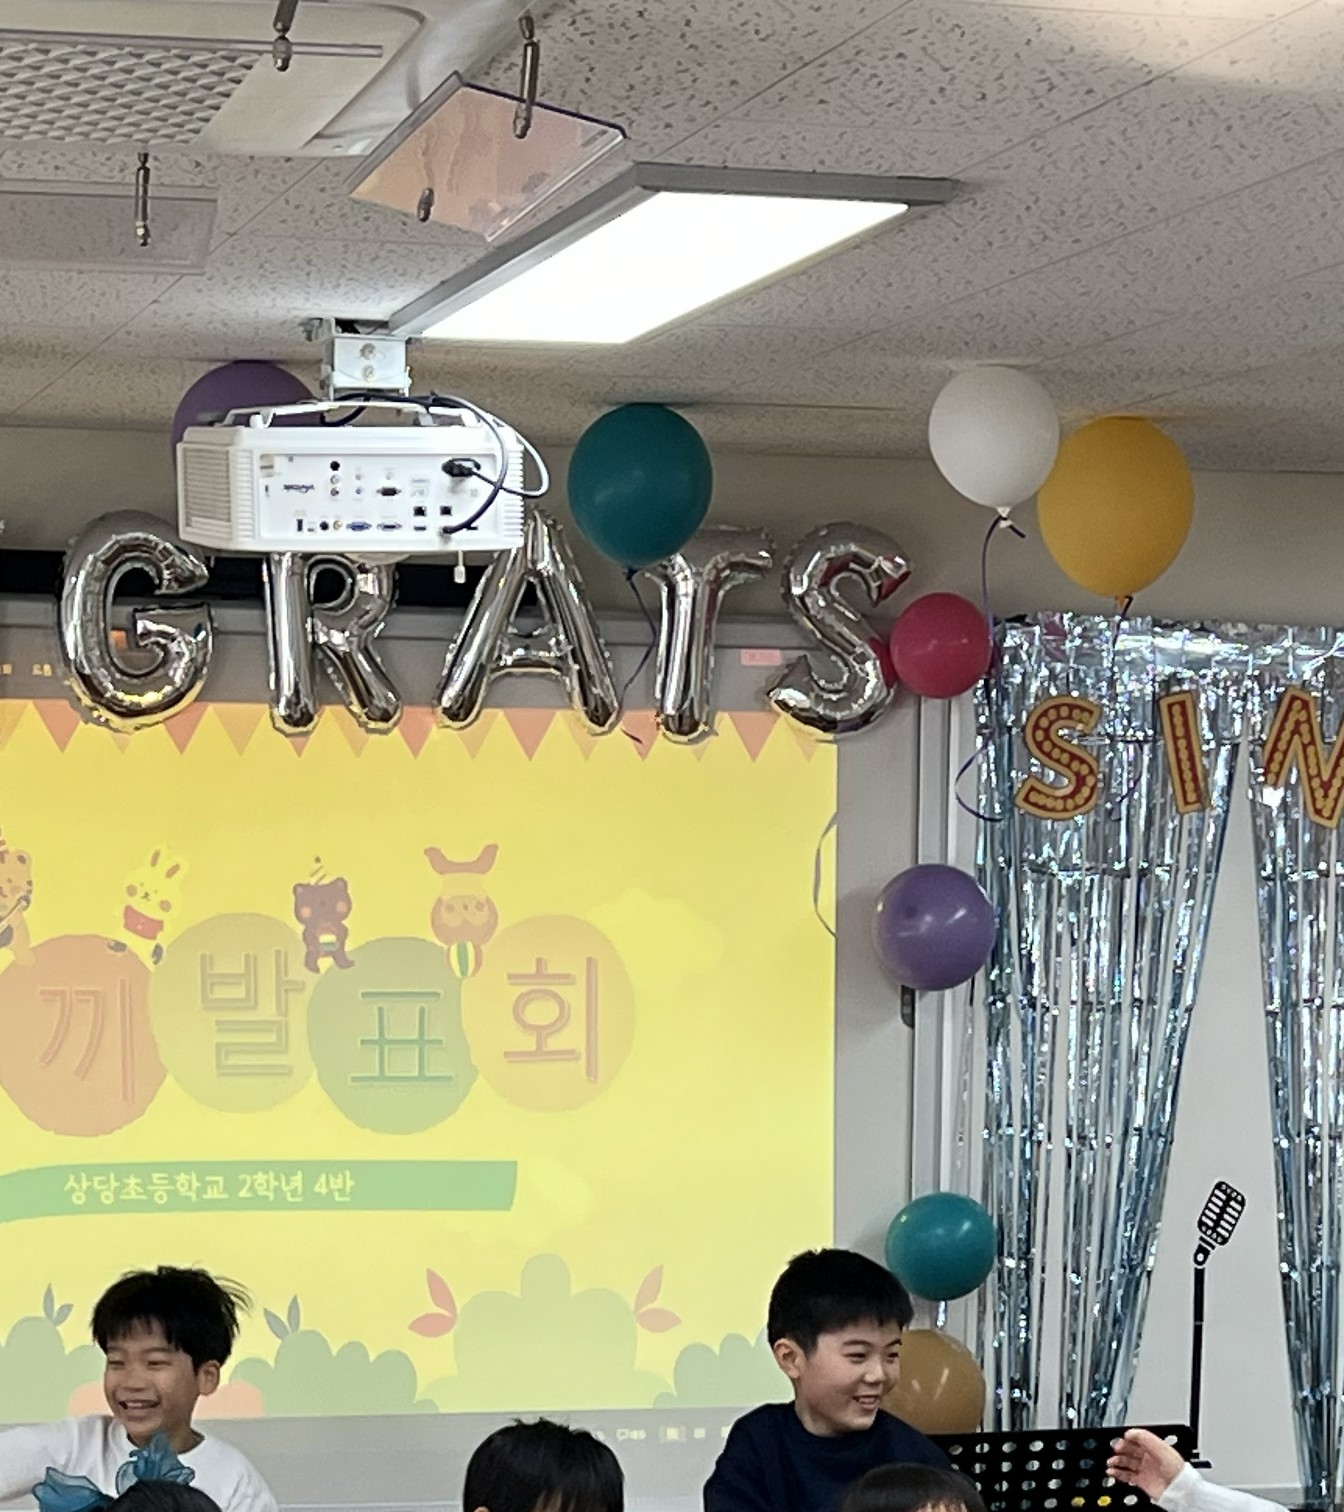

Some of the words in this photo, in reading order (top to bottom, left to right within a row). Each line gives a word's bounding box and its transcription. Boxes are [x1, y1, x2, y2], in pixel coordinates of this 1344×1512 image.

[64, 1170, 229, 1206] 상당초등학교
[237, 1170, 304, 1202] 2학년
[313, 1170, 355, 1202] 4반
